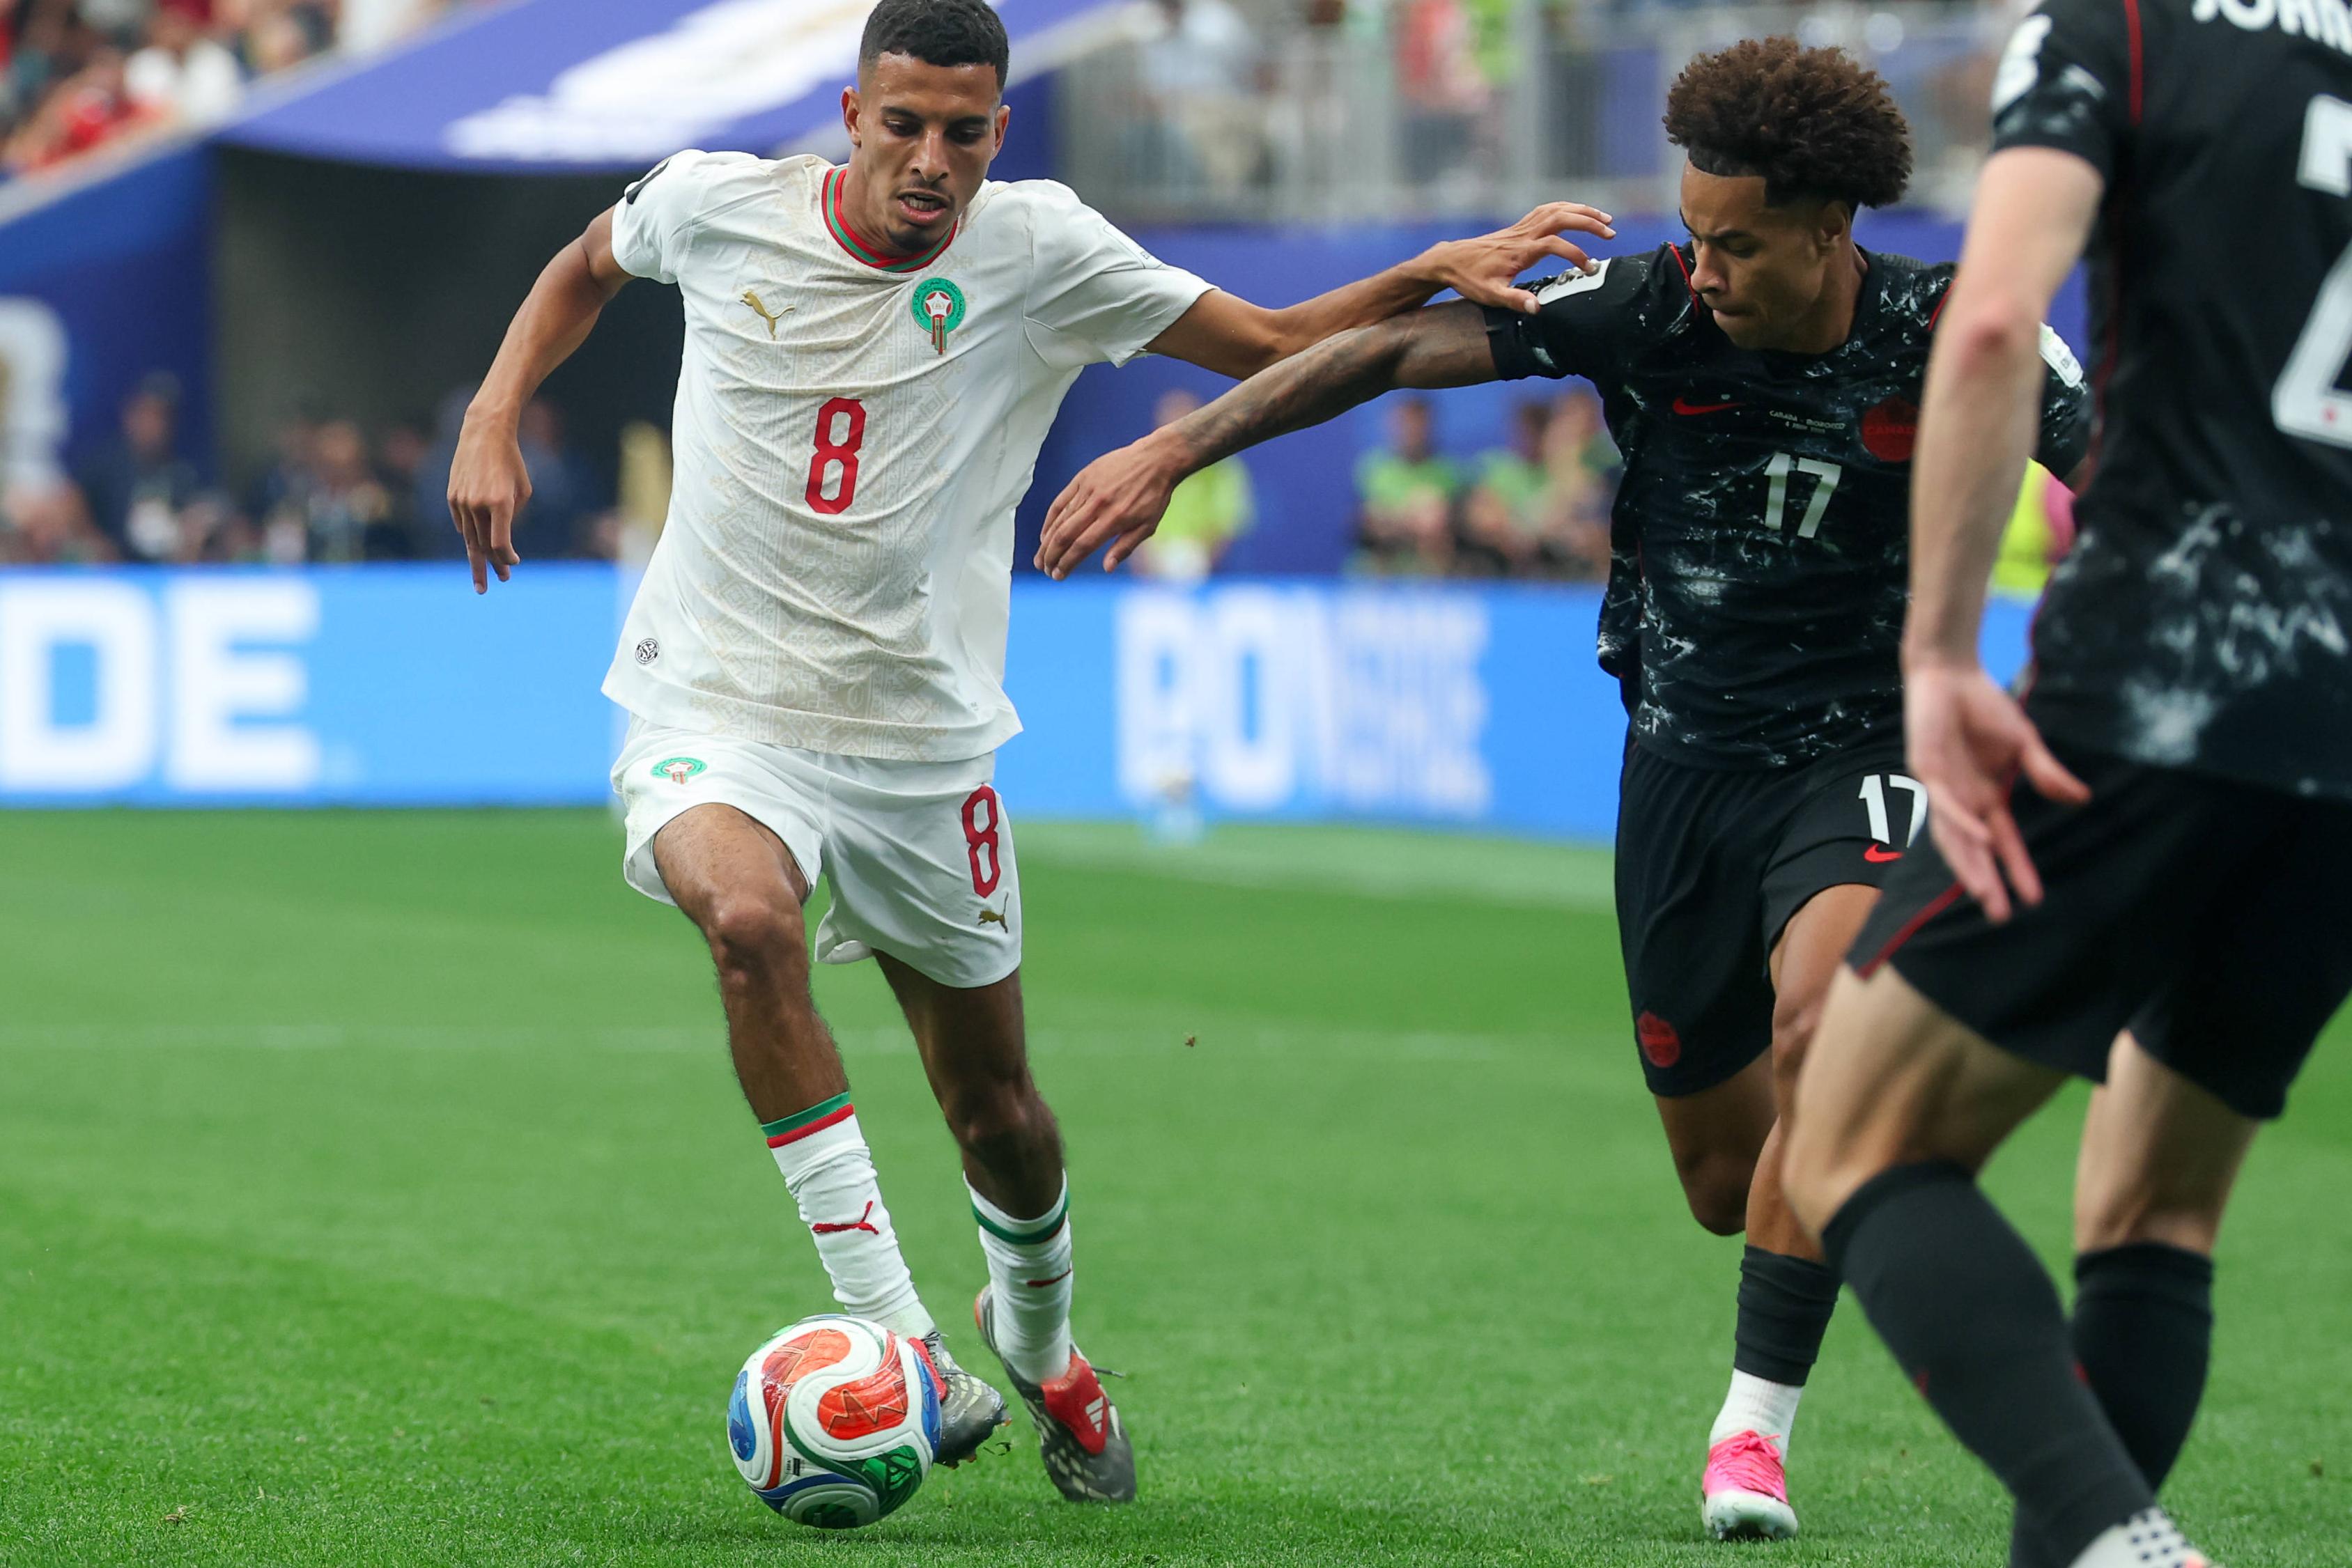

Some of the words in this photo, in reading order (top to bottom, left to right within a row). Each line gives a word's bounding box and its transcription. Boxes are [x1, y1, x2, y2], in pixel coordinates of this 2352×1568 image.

[805, 396, 866, 515] 8
[1764, 452, 1841, 538] 17
[0, 578, 320, 791] DE
[961, 785, 1000, 899] 8
[1858, 773, 1928, 848] 17
